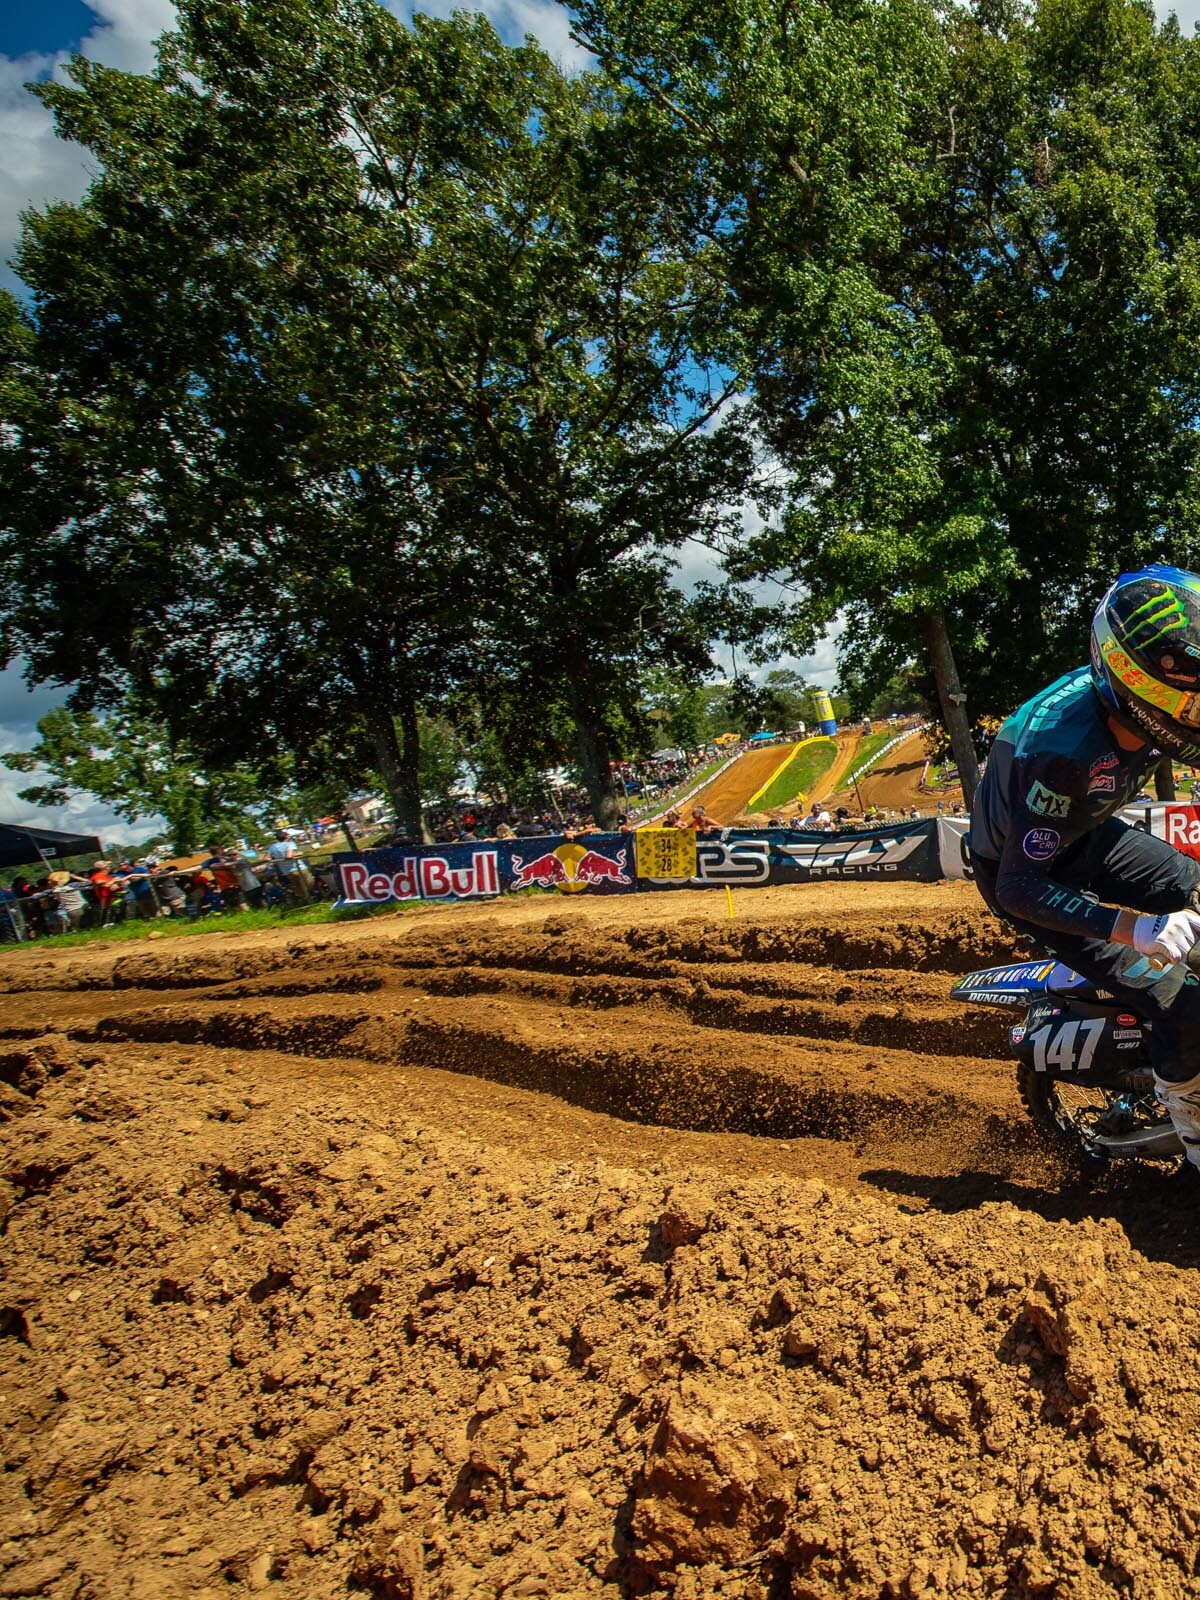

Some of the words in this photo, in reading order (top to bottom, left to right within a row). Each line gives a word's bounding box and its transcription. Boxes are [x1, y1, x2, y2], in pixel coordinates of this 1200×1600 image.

[1031, 788, 1066, 815] MX
[661, 839, 672, 852] 34
[661, 858, 672, 872] 28
[809, 865, 898, 876] RACING
[341, 857, 421, 902] Red
[420, 850, 500, 897] Bull
[968, 992, 1017, 1005] DUNLOP
[1029, 1017, 1106, 1072] 147
